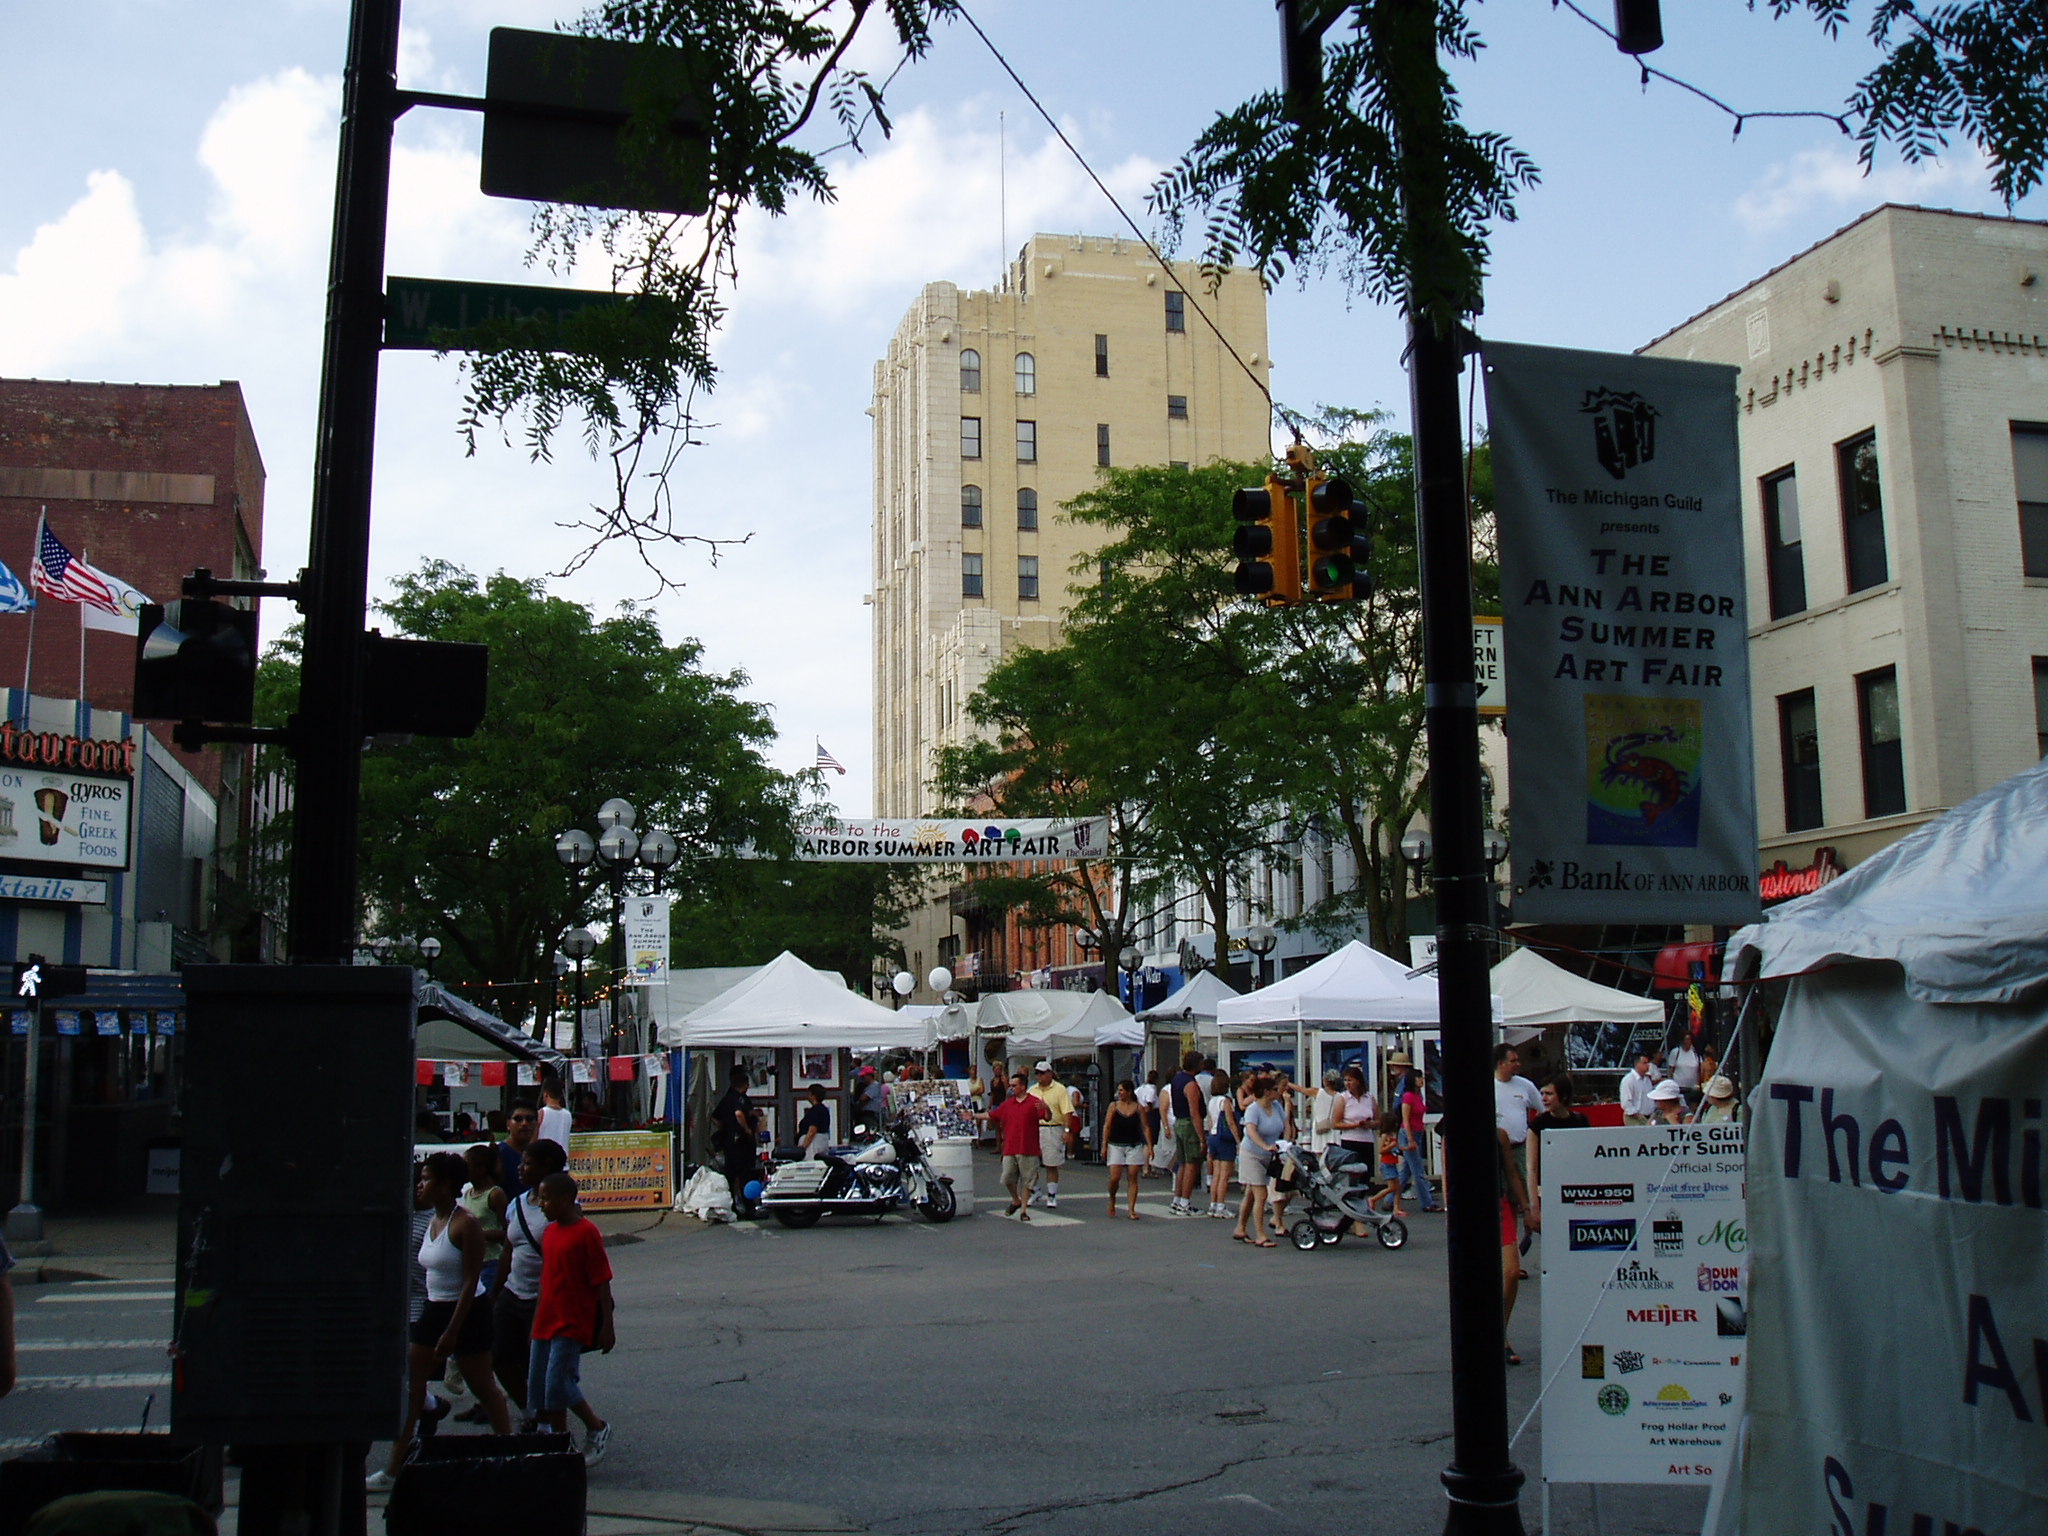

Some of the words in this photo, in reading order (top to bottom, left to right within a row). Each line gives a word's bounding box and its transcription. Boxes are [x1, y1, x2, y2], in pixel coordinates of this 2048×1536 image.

[401, 291, 430, 328] W
[1546, 488, 1578, 504] The
[1583, 490, 1660, 510] Michigan
[1665, 494, 1703, 512] Guild
[1600, 520, 1660, 535] presents
[1590, 549, 1670, 576] THE
[1523, 579, 1603, 610] ANN
[1615, 586, 1735, 617] ARBOR
[1559, 616, 1715, 650] SUMMER
[1554, 654, 1628, 682] ART
[1642, 658, 1722, 687] FAIR
[1589, 712, 1697, 730] SUMMER
[2, 775, 23, 788] ON
[81, 807, 112, 821] FINE
[79, 822, 117, 840] GREEK
[847, 825, 864, 837] to
[872, 823, 900, 837] the
[79, 842, 118, 857] FOODS
[802, 839, 869, 856] ARBOR
[875, 840, 955, 857] SUMMER
[963, 838, 1006, 857] ART
[1012, 836, 1060, 857] FAIR
[1561, 861, 1631, 891] Bank
[1634, 873, 1653, 889] OF
[1657, 873, 1695, 890] ANN
[1698, 873, 1750, 892] ARBOR
[1667, 1128, 1702, 1141] The
[1770, 1083, 1910, 1194] The
[1594, 1145, 1630, 1158] Ann
[1637, 1143, 1690, 1156] Arbor
[1671, 1162, 1711, 1173] Official
[1577, 1227, 1629, 1243] DASANI
[1617, 1267, 1660, 1281] Bank
[1617, 1281, 1640, 1290] ANN
[1641, 1281, 1674, 1290] ARBOR
[1641, 1423, 1664, 1433] Frog
[1650, 1438, 1665, 1446] Art
[1668, 1465, 1690, 1476] Art
